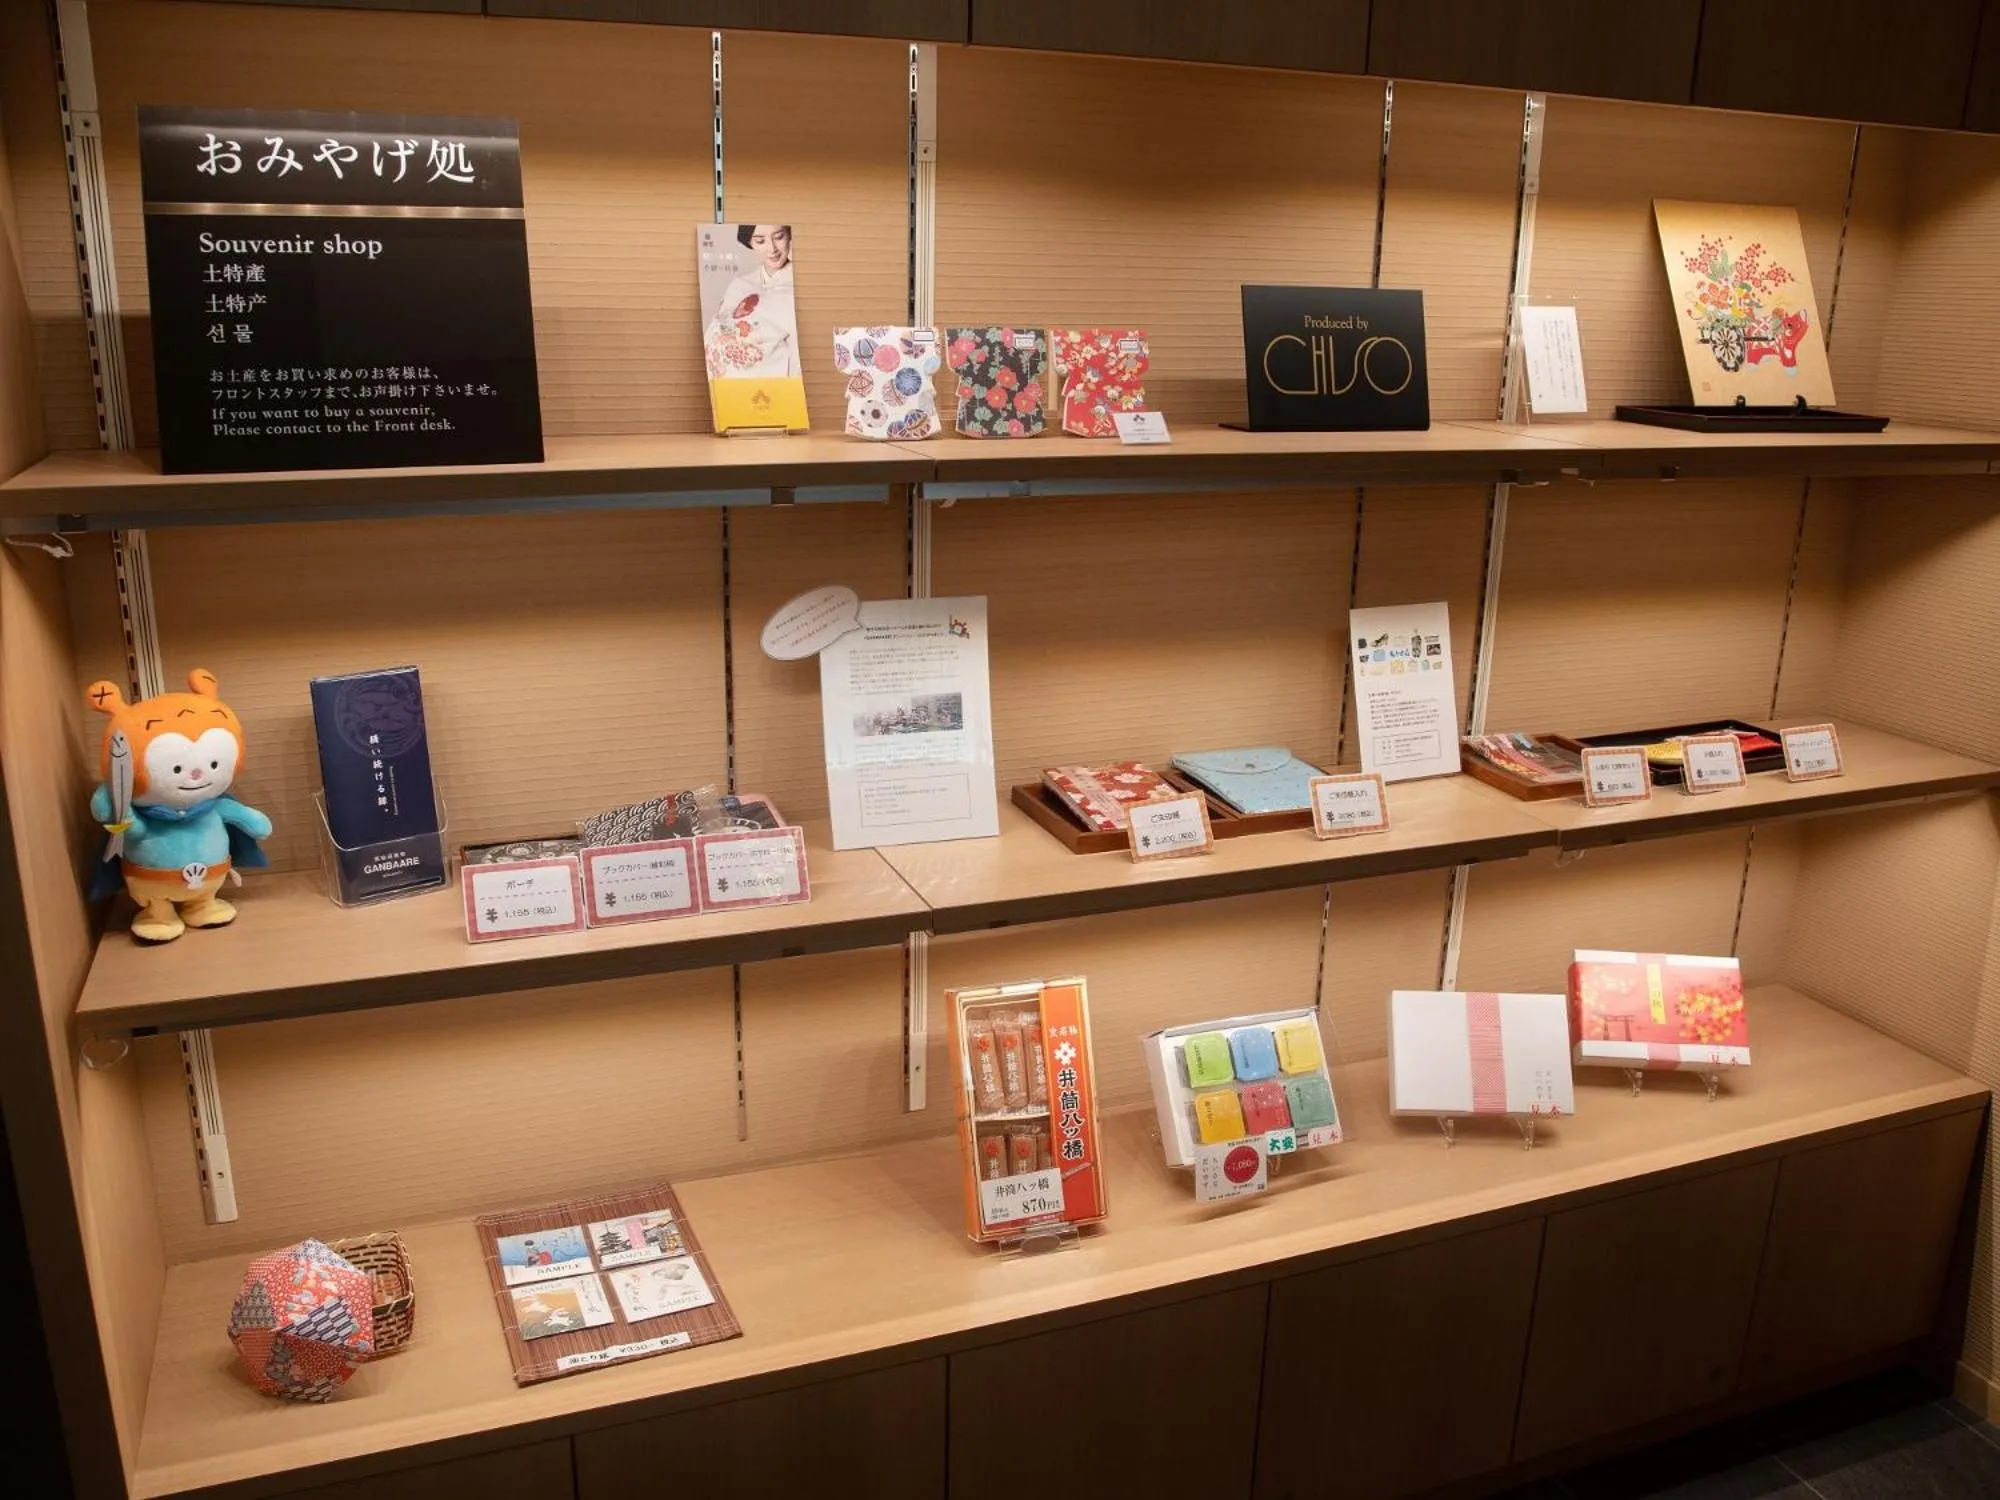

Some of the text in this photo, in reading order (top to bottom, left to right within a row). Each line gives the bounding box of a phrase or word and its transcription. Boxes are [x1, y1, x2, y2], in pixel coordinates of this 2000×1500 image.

[197, 133, 476, 184] おみやげ処
[200, 232, 382, 259] Souvenir shop
[202, 263, 266, 283] 土特産
[205, 293, 267, 313] 土特产
[1304, 314, 1369, 331] Produced by
[211, 404, 436, 422] If you want to buy a souvenir,
[213, 418, 456, 436] Please contact to the Front desk.
[363, 856, 420, 875] GANBAARE
